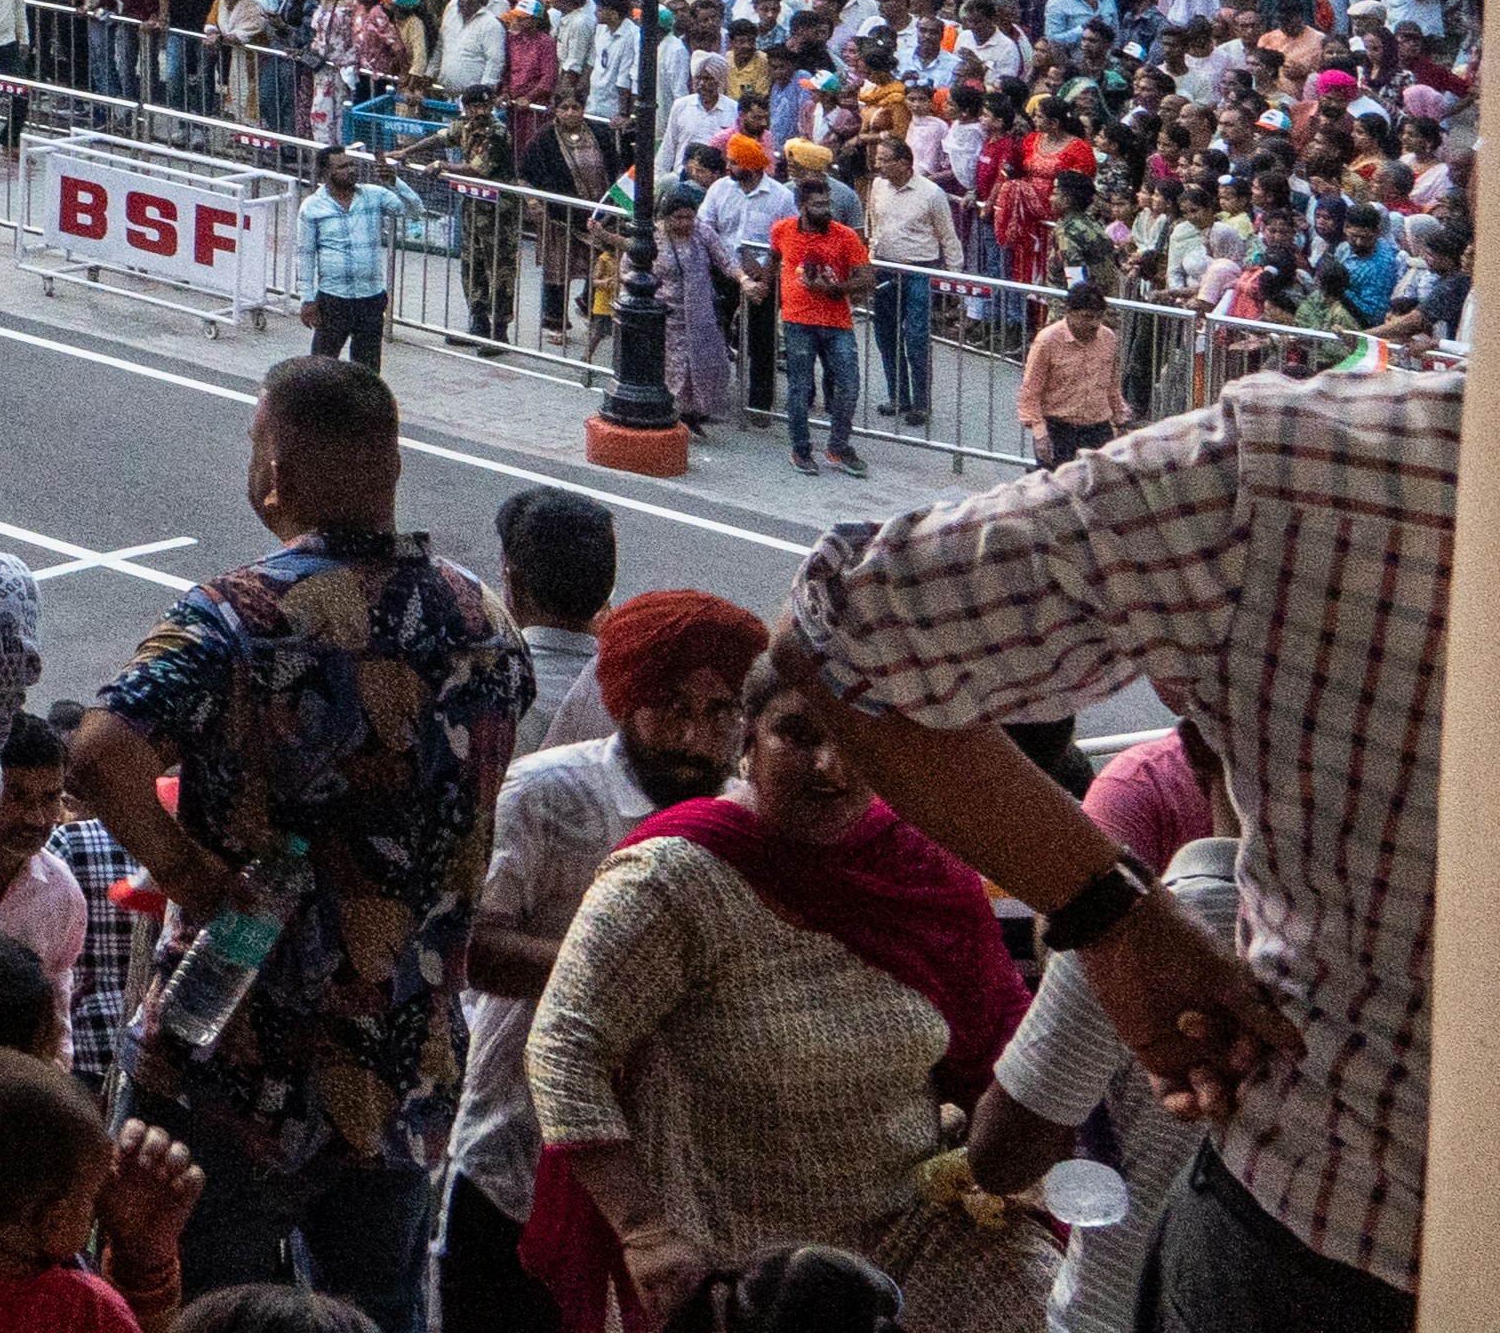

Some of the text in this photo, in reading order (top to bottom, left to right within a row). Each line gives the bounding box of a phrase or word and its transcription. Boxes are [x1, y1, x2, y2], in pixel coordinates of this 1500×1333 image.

[240, 135, 271, 149] BSF
[457, 183, 490, 198] BSF
[58, 174, 250, 267] BSF
[939, 281, 982, 296] BSF
